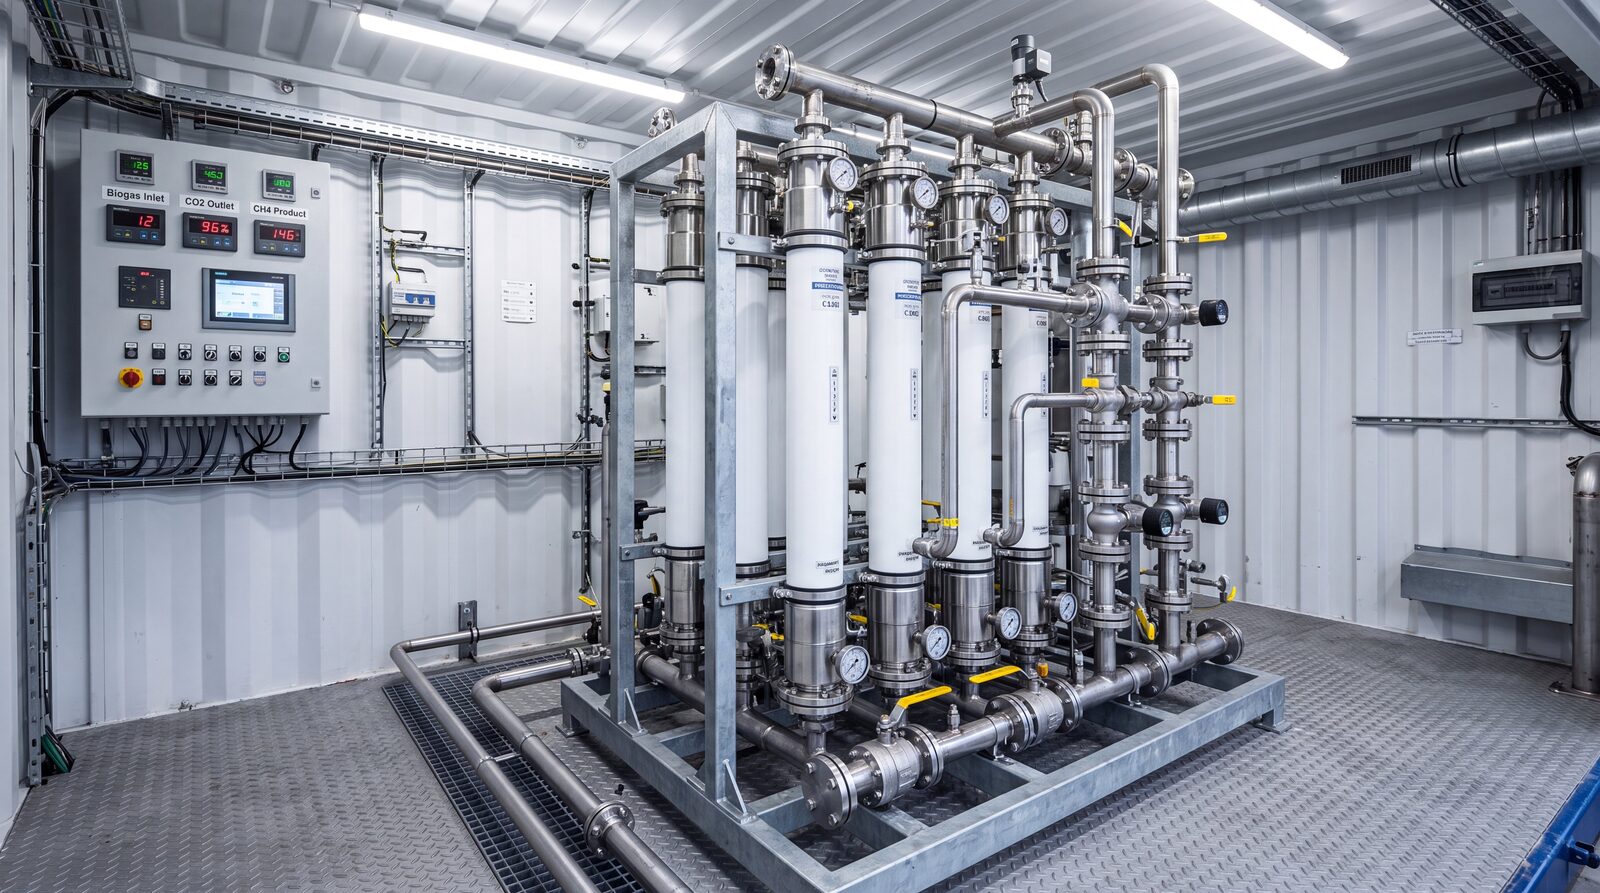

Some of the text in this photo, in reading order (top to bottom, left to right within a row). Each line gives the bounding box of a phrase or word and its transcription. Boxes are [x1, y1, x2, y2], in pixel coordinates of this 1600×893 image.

[107, 188, 165, 203] Biogas Inlet
[185, 197, 234, 210] CO2 Outlet
[253, 204, 306, 218] CH4 Product
[138, 215, 154, 227] 12
[202, 221, 229, 234] 96%
[273, 229, 295, 241] 146
